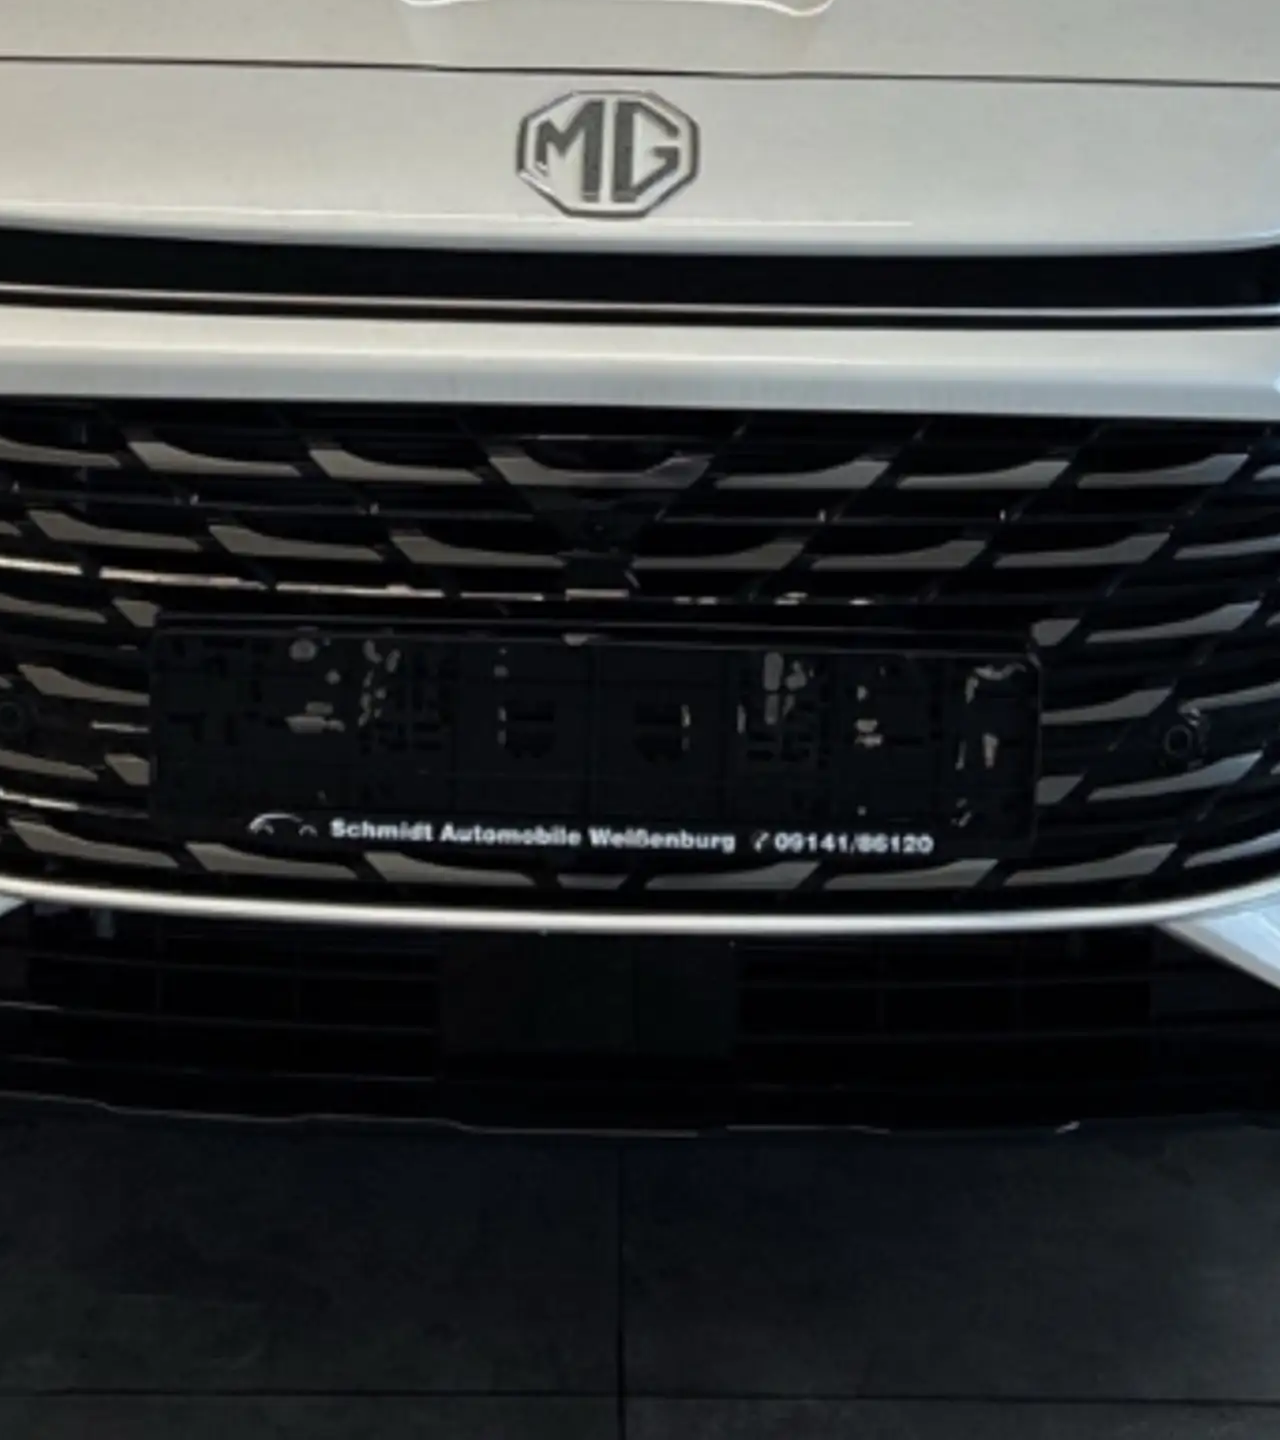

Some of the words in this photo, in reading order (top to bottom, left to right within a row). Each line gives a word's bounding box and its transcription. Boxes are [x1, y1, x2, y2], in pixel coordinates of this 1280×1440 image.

[534, 99, 680, 203] MG
[329, 818, 433, 842] Schmidt
[439, 822, 582, 846] Automobile
